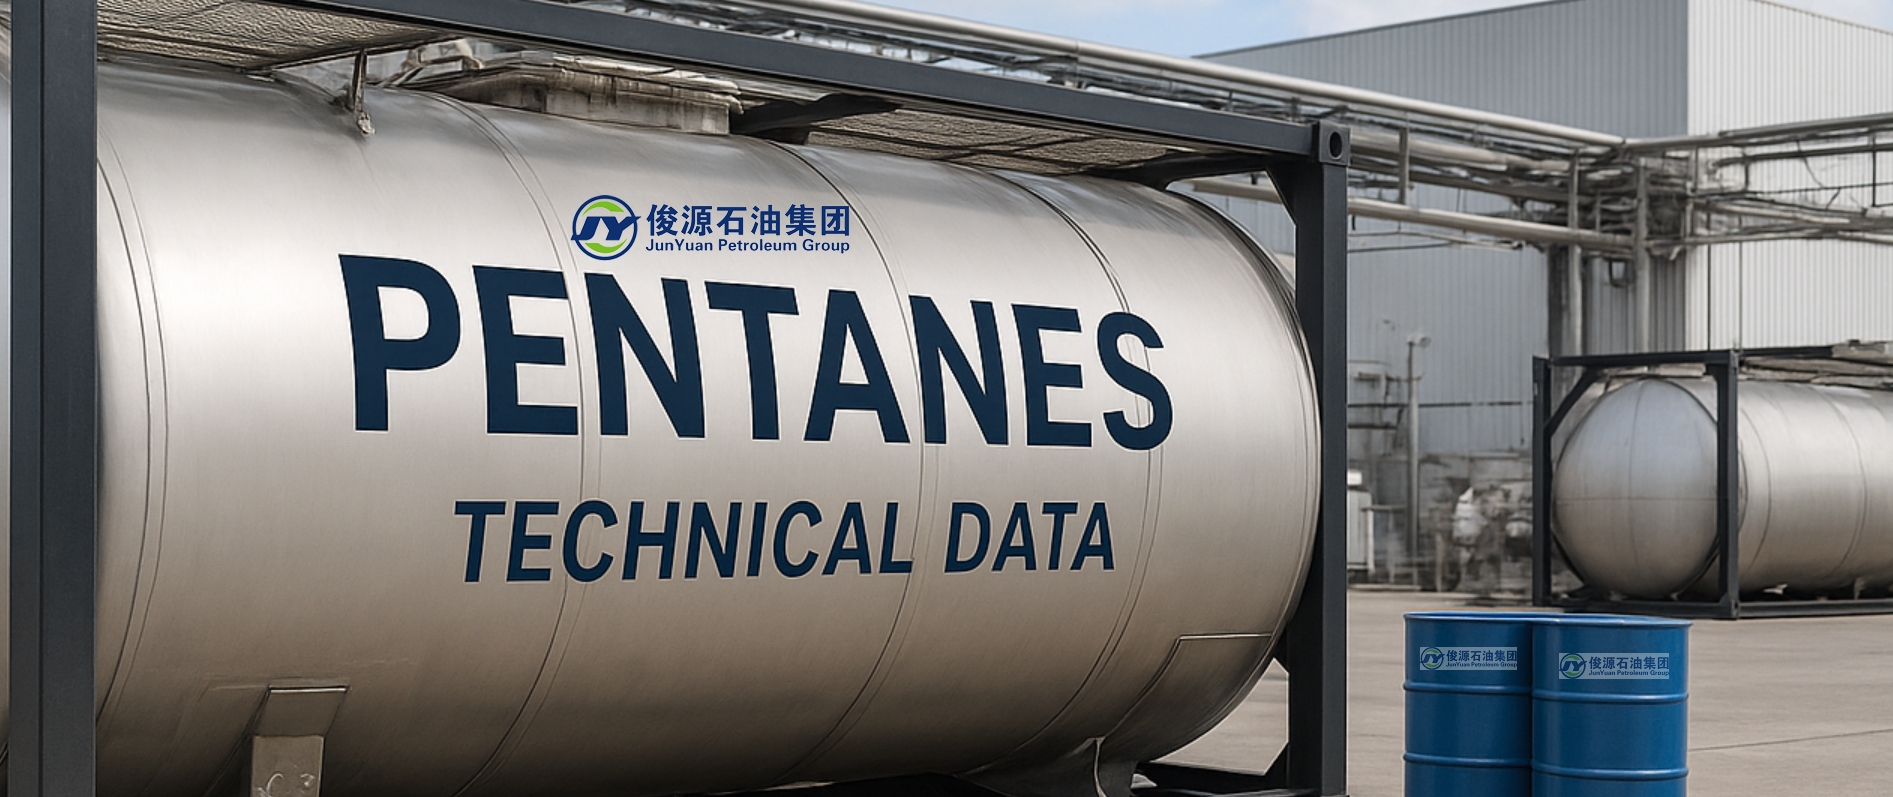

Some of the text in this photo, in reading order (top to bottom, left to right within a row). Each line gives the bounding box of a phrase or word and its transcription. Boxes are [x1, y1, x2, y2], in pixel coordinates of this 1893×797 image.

[339, 254, 1172, 450] PENTANES
[454, 501, 1114, 582] TECHNICAL DATA
[1446, 650, 1517, 661] 俊源石油集团
[1589, 656, 1669, 669] 俊源石油集团
[1649, 669, 1669, 677] Group
